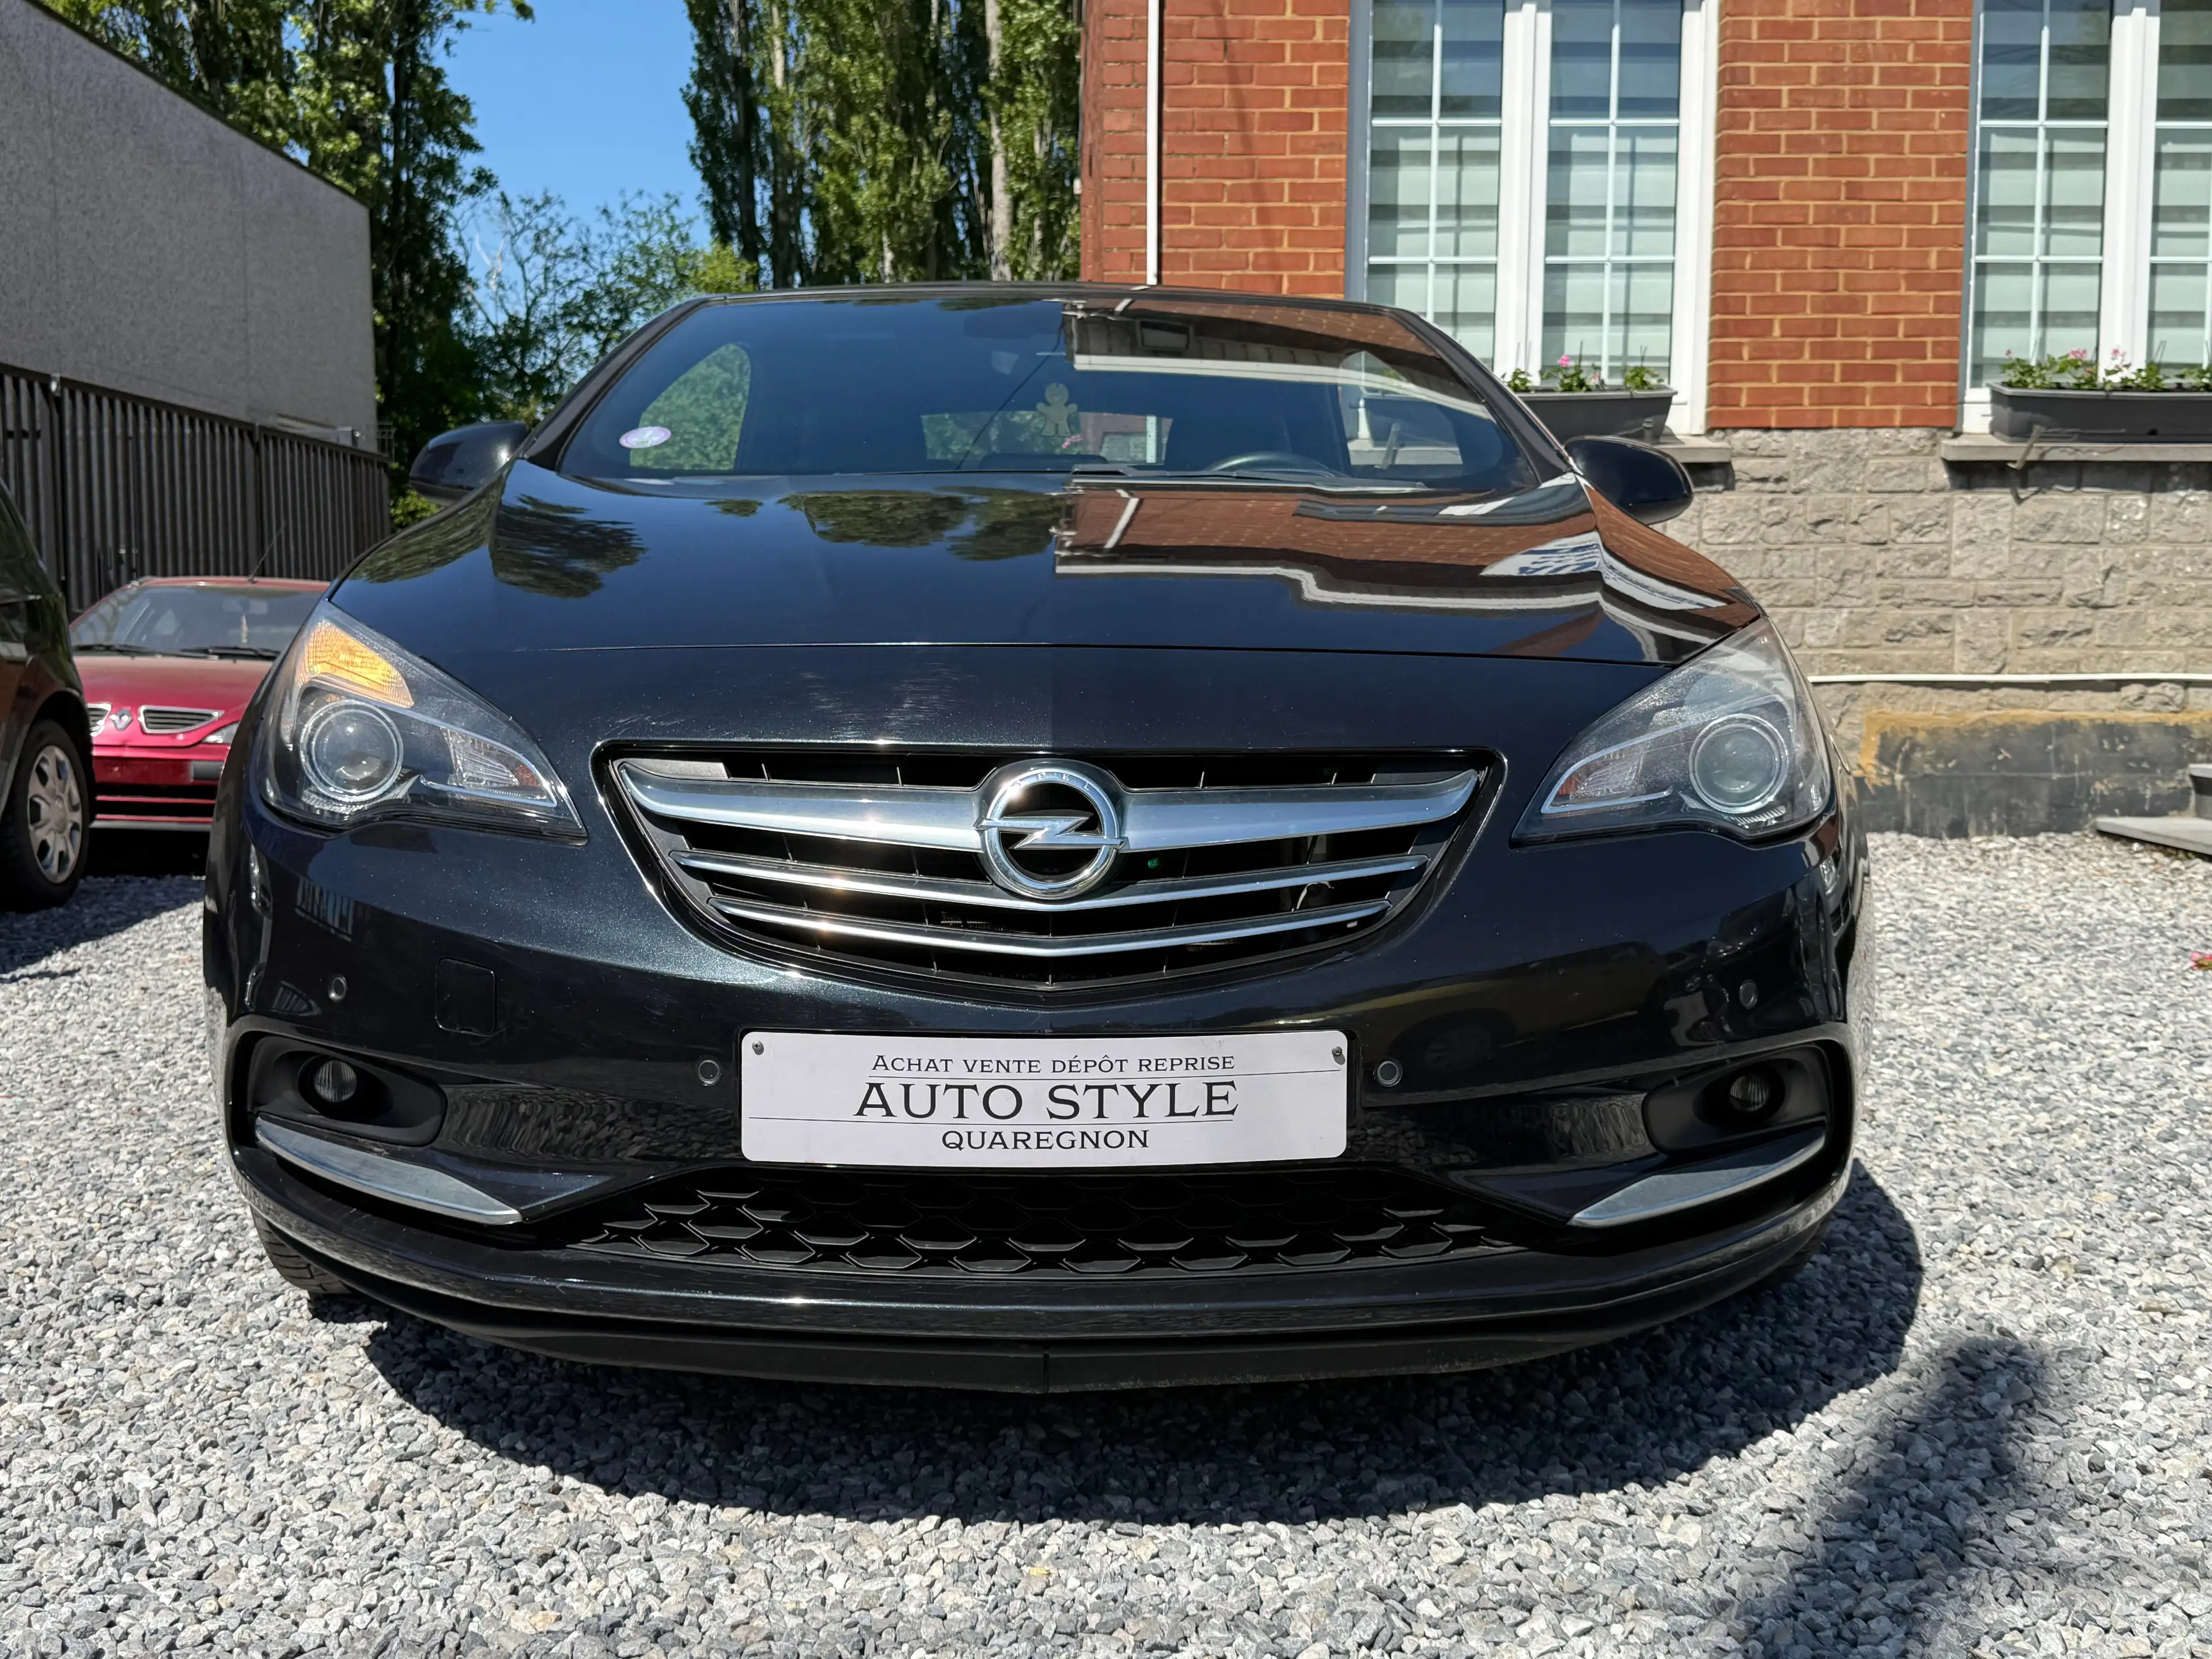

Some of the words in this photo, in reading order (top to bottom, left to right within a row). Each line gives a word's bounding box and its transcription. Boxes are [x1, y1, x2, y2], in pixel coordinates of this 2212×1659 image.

[1010, 771, 1090, 791] PEL
[871, 1055, 953, 1072] ACHAT
[962, 1059, 1041, 1073] VENTE
[1051, 1054, 1128, 1073] DÉPÔT
[1138, 1056, 1236, 1072] REPRISE
[853, 1082, 1023, 1120] AUTO
[1046, 1080, 1239, 1120] STYLE
[942, 1130, 1150, 1151] QUAREGNON
